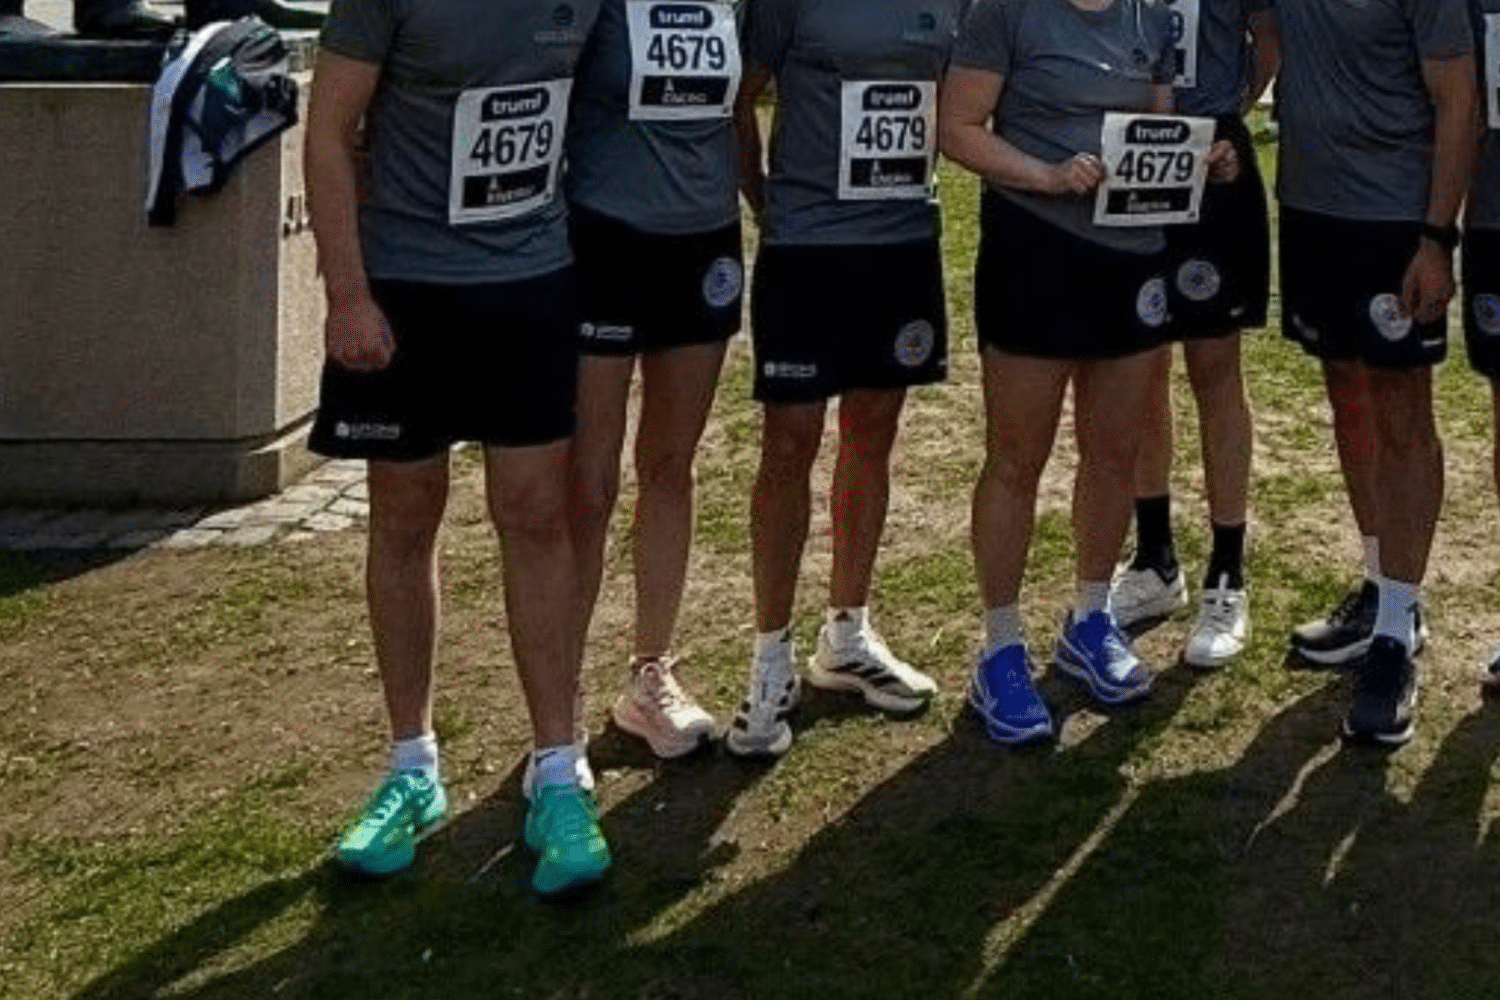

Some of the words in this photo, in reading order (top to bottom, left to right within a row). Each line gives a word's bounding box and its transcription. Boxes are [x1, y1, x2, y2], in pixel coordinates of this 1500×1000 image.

[647, 33, 726, 70] 4679
[470, 119, 553, 168] 4679
[856, 116, 925, 151] 4679
[1115, 149, 1194, 184] 4679
